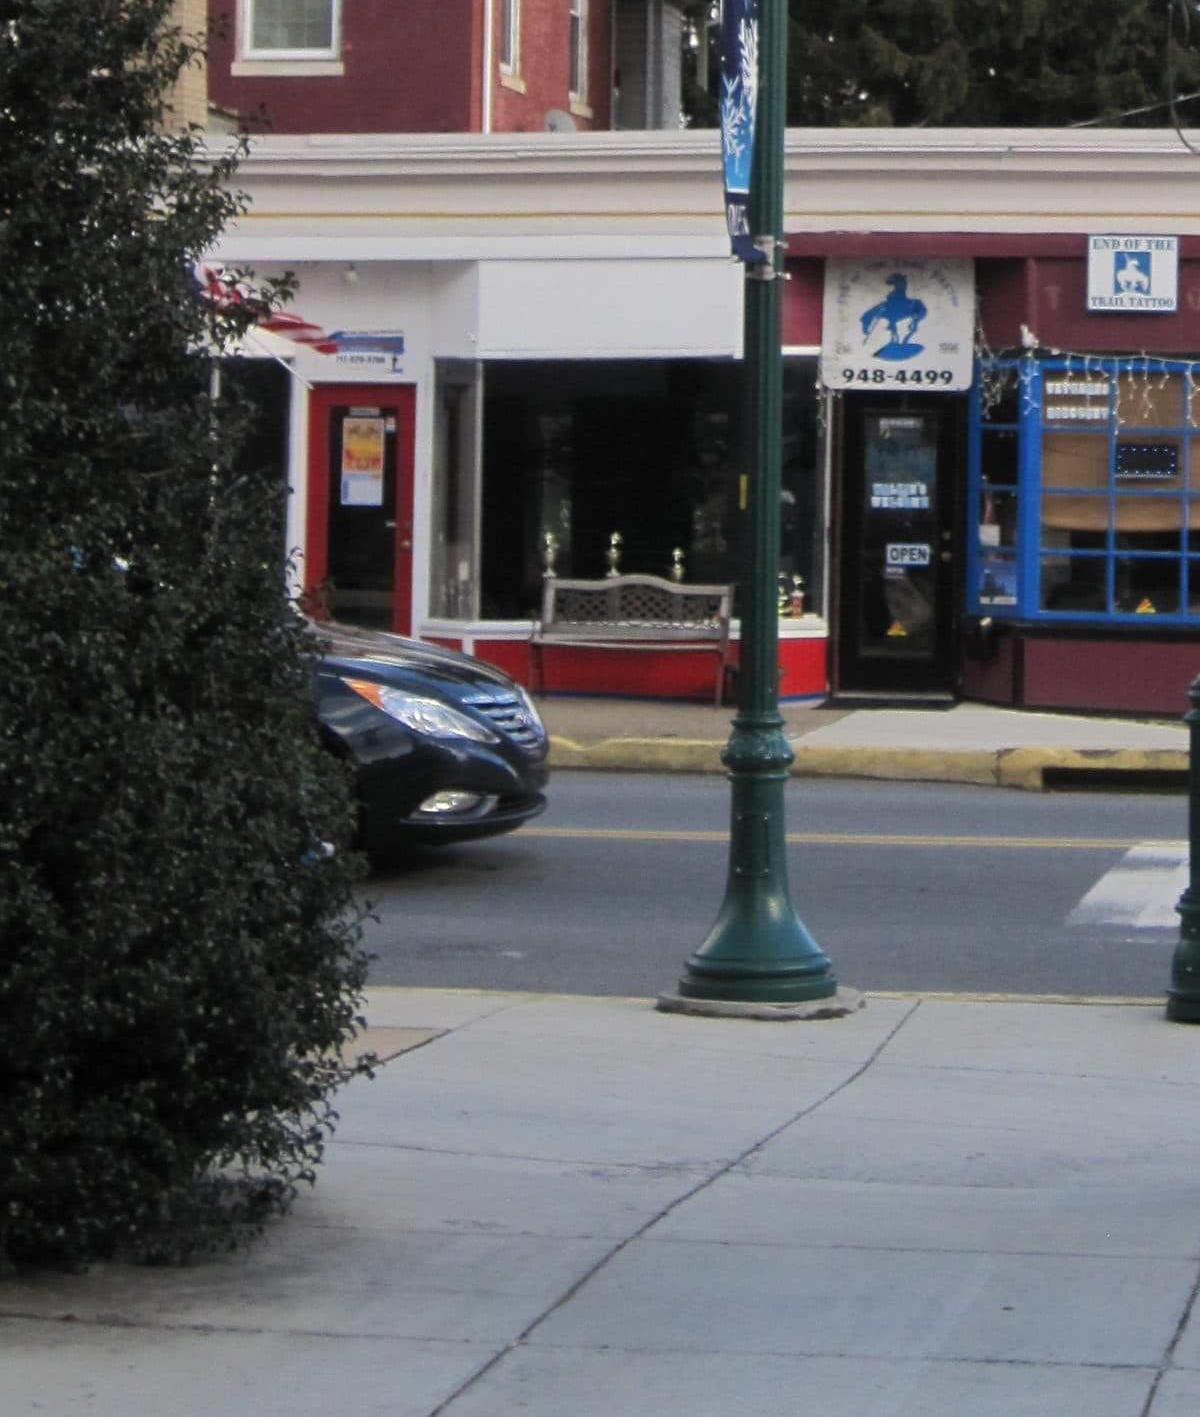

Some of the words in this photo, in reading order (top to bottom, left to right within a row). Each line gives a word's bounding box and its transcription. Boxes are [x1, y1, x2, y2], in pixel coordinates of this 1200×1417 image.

[1093, 238, 1120, 250] END
[1124, 238, 1141, 250] OF
[1146, 238, 1174, 250] THE
[1091, 297, 1124, 308] TRAIL
[1128, 297, 1175, 308] TATTOO
[842, 368, 953, 385] 948-4499
[889, 547, 929, 562] OPEN
